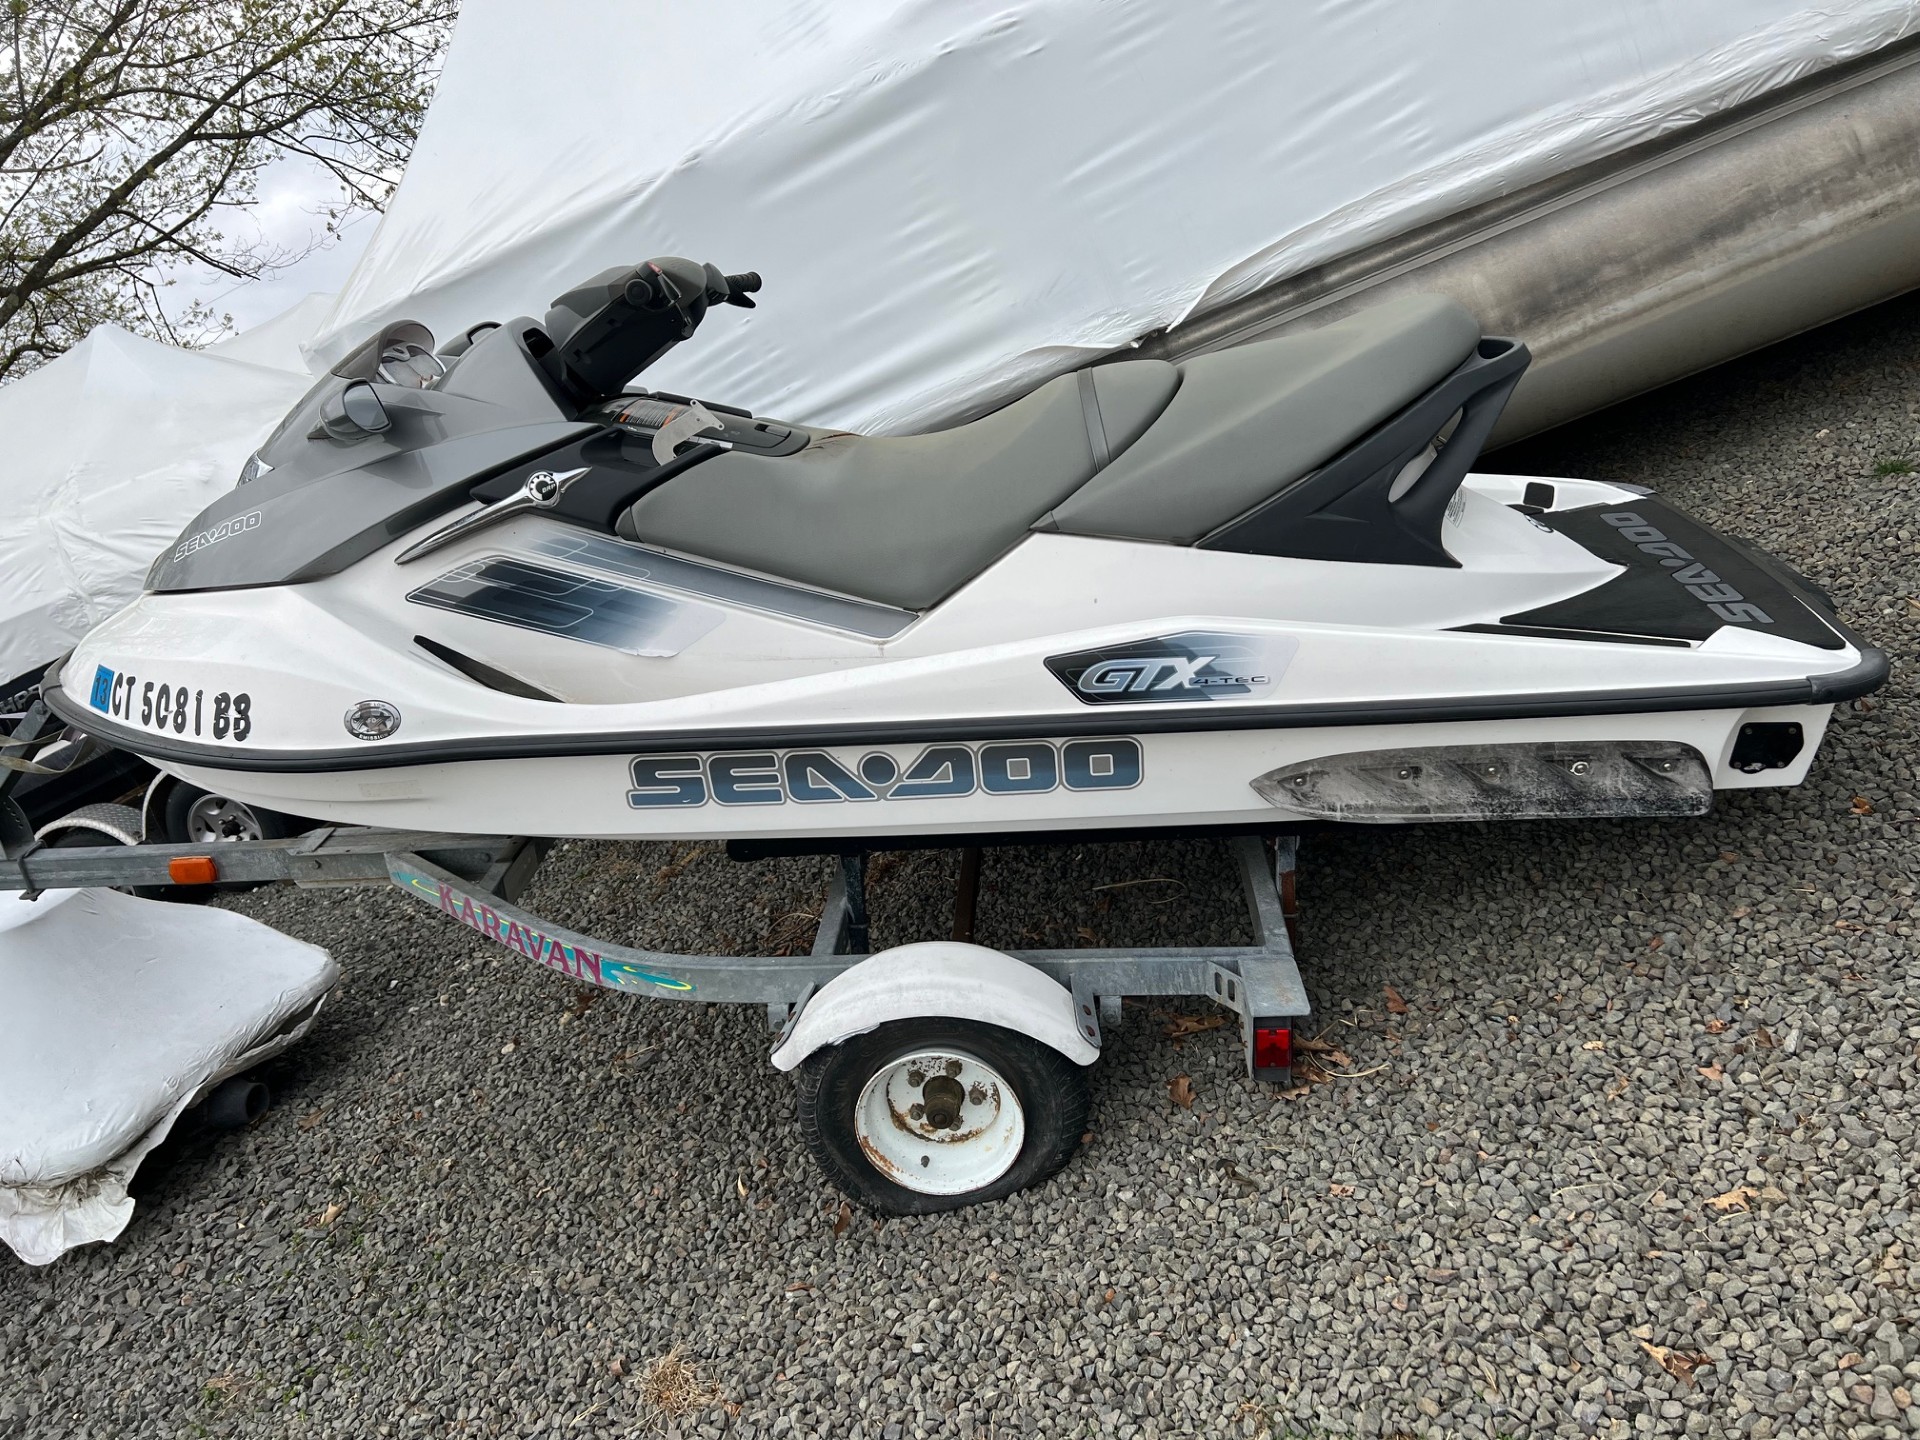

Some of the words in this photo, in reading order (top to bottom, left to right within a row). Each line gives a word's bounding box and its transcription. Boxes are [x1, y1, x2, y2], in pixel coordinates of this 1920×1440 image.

[95, 674, 110, 706] 13
[1077, 653, 1221, 694] GTX
[1190, 675, 1270, 686] 4-TEC
[111, 671, 137, 721] CT
[141, 681, 204, 734] 5081
[212, 691, 252, 742] BB
[438, 881, 603, 986] KARAVAN
